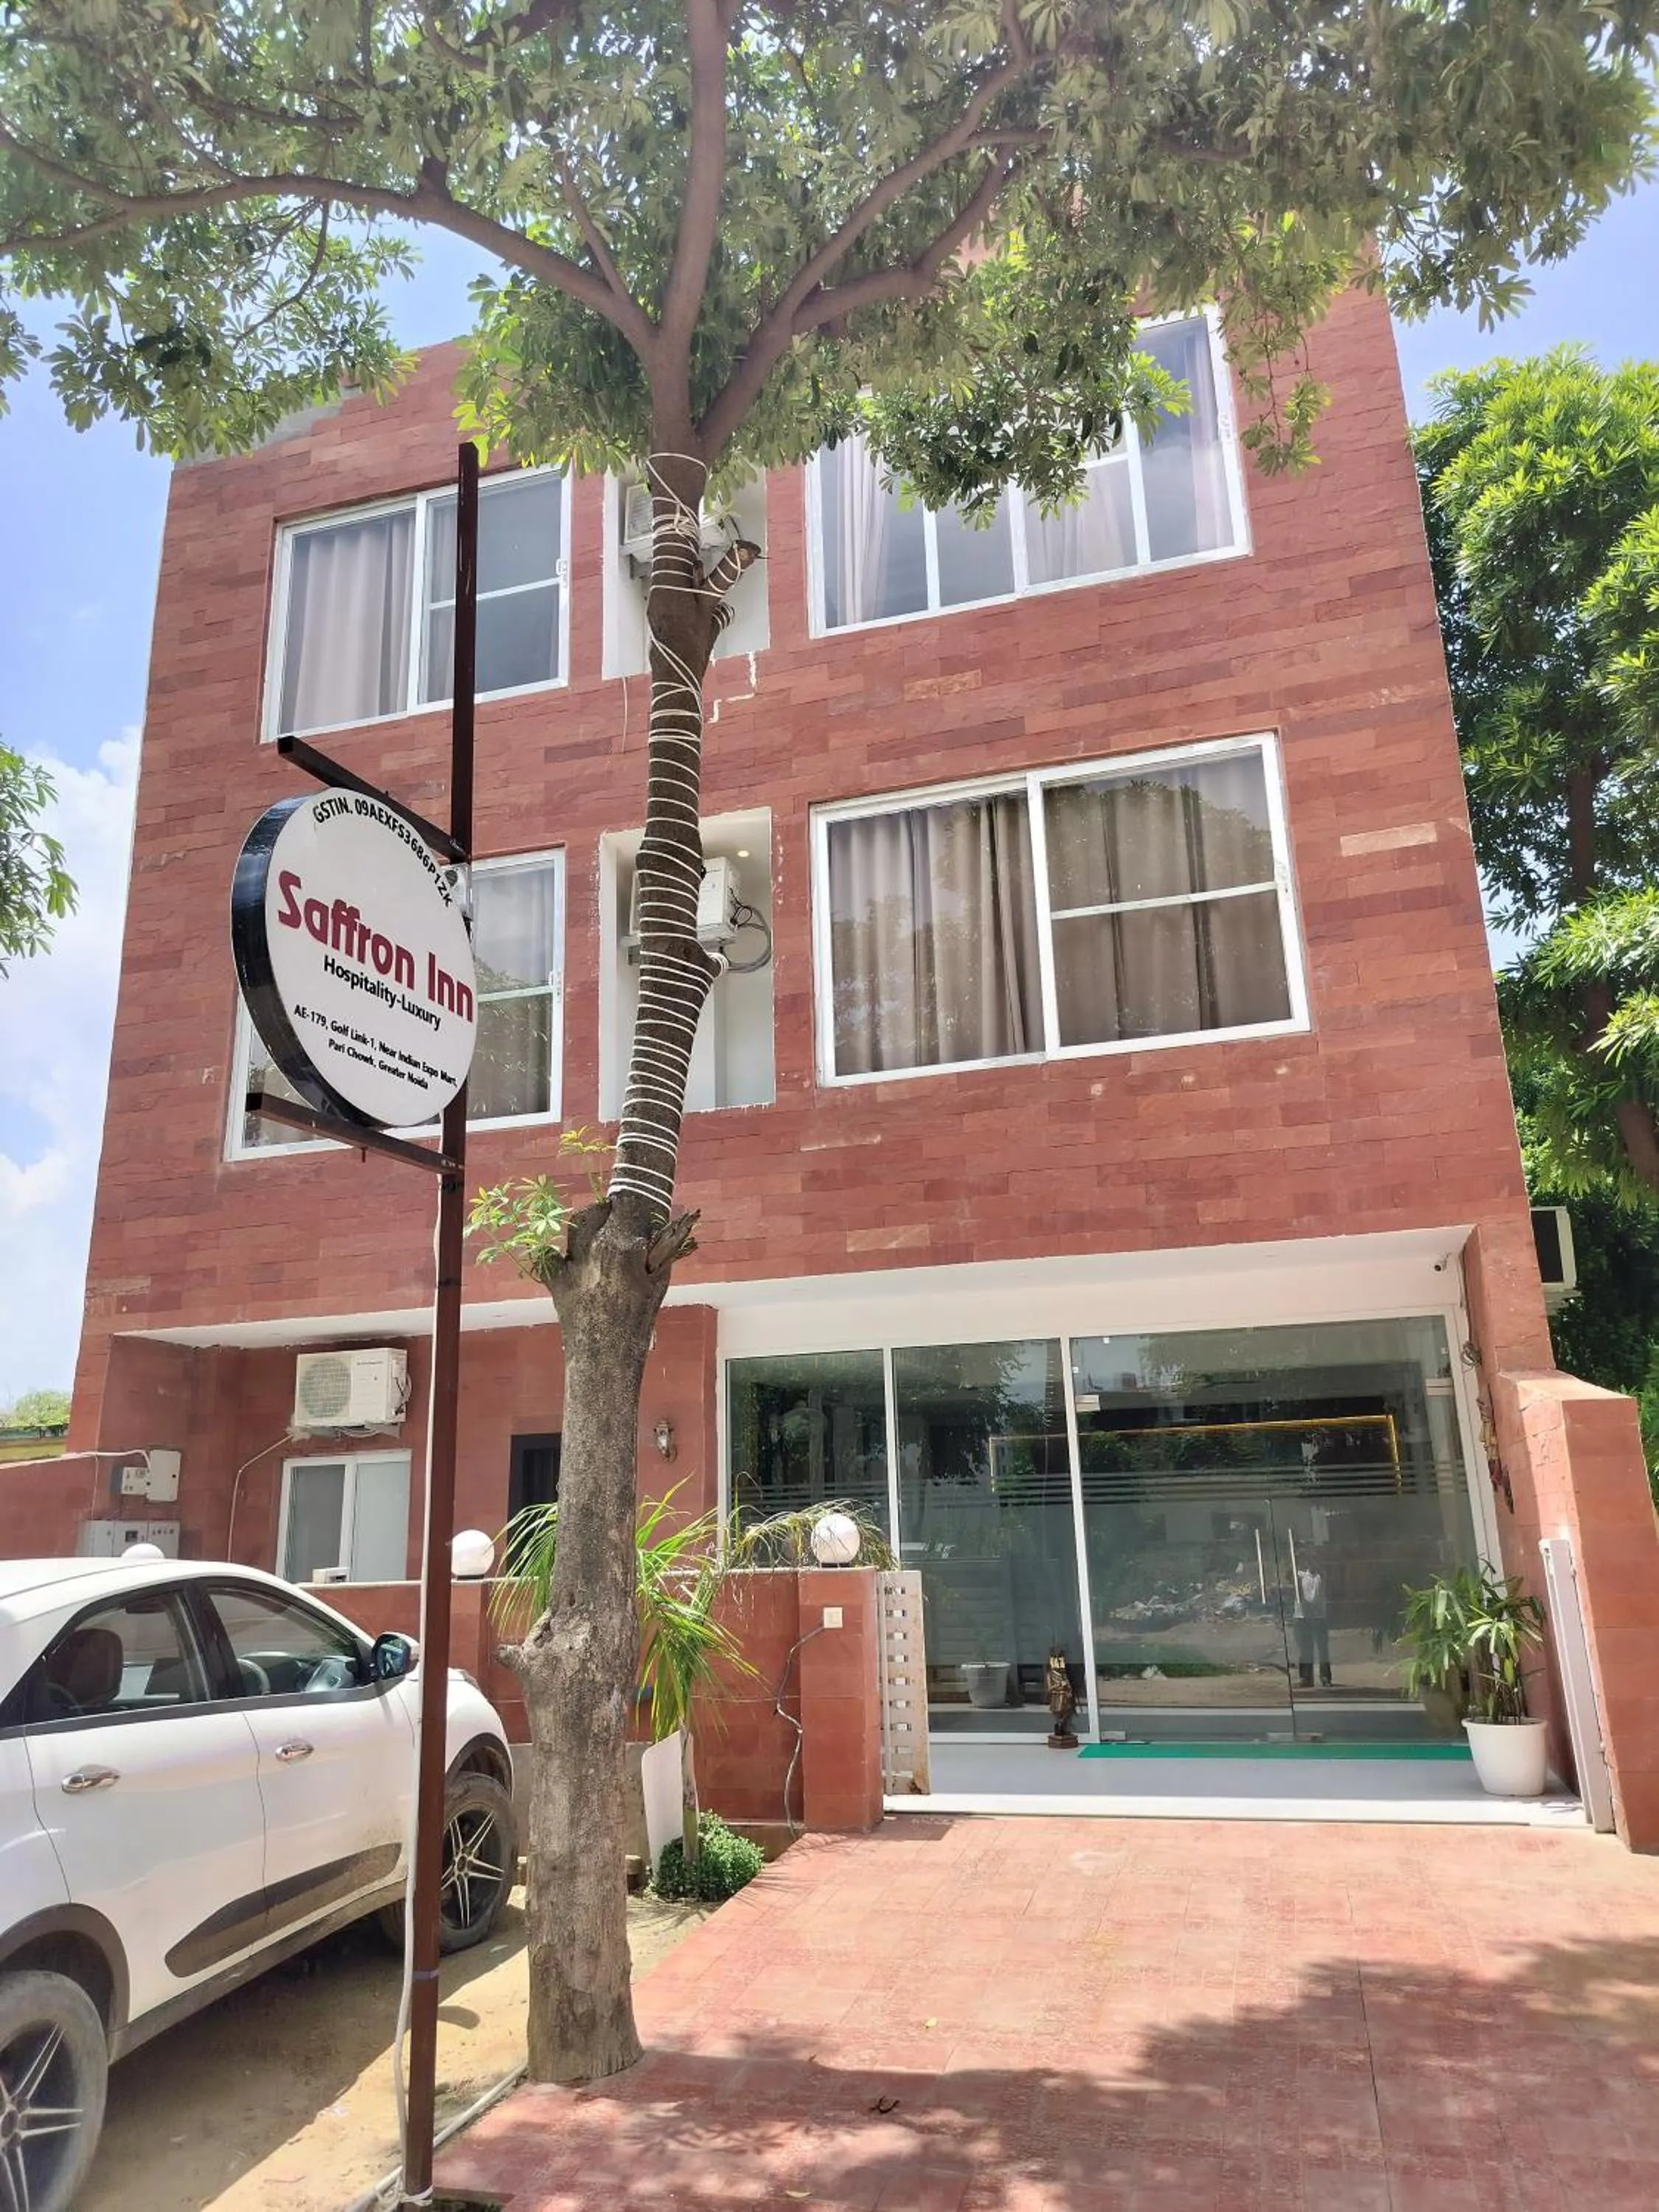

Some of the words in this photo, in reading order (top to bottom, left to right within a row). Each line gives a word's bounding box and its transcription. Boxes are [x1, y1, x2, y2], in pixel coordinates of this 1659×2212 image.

[313, 797, 353, 823] GSTIN.
[278, 870, 414, 990] Saffron
[428, 952, 473, 1023] Inn
[324, 955, 441, 1031] Hospitality-Luxury
[294, 1004, 328, 1029] AE-179,
[330, 1020, 349, 1037] Golf
[379, 1040, 397, 1058] Near
[422, 1062, 439, 1077] Expo
[328, 1037, 346, 1054] Pari
[378, 1060, 406, 1079] Greater
[407, 1071, 428, 1090] Noida
